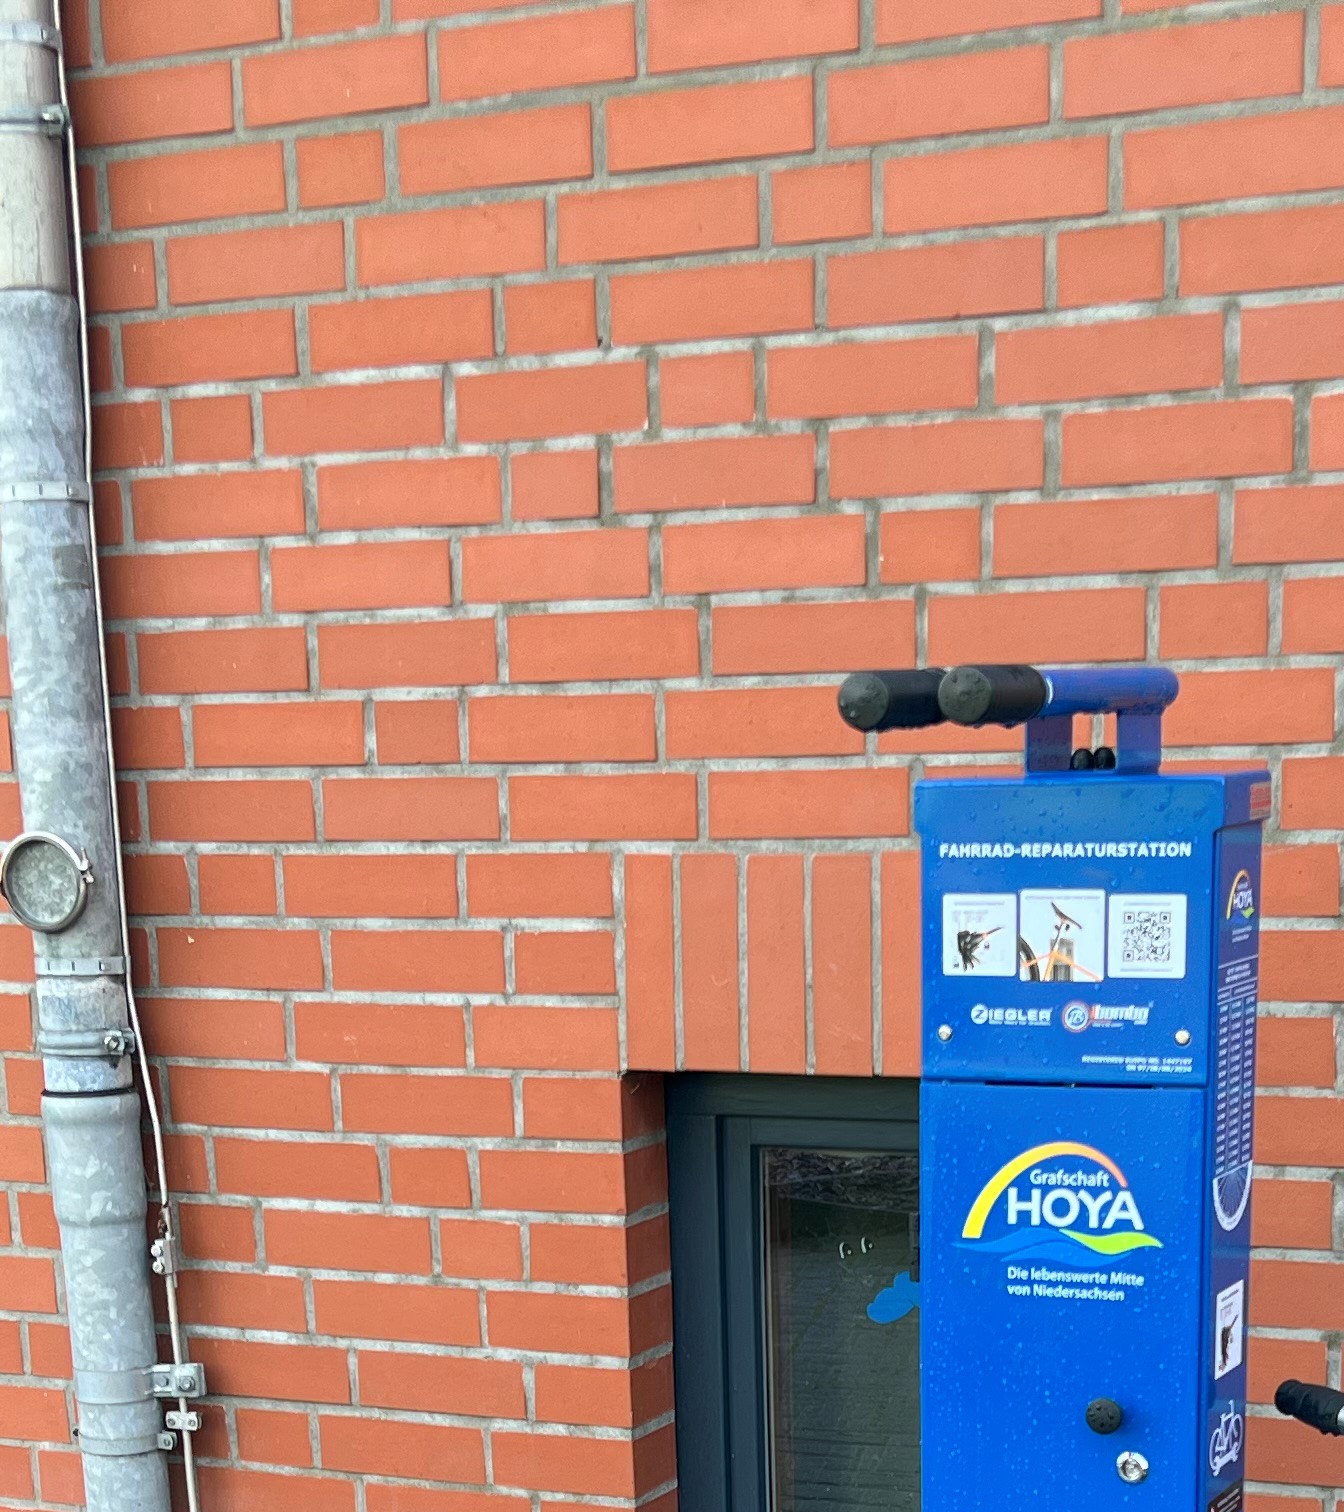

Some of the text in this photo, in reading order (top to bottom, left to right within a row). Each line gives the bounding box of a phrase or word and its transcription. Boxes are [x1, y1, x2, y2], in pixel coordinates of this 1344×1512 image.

[939, 842, 1192, 858] FAHRRAD-REPARATURSTATION
[971, 1003, 1053, 1024] ZIEGLER
[1030, 1168, 1110, 1188] Grafschaft
[1007, 1187, 1145, 1231] HOYA
[1007, 1266, 1145, 1287] Die lebenswerte Mitte
[1007, 1284, 1126, 1302] von Niedersachsen
